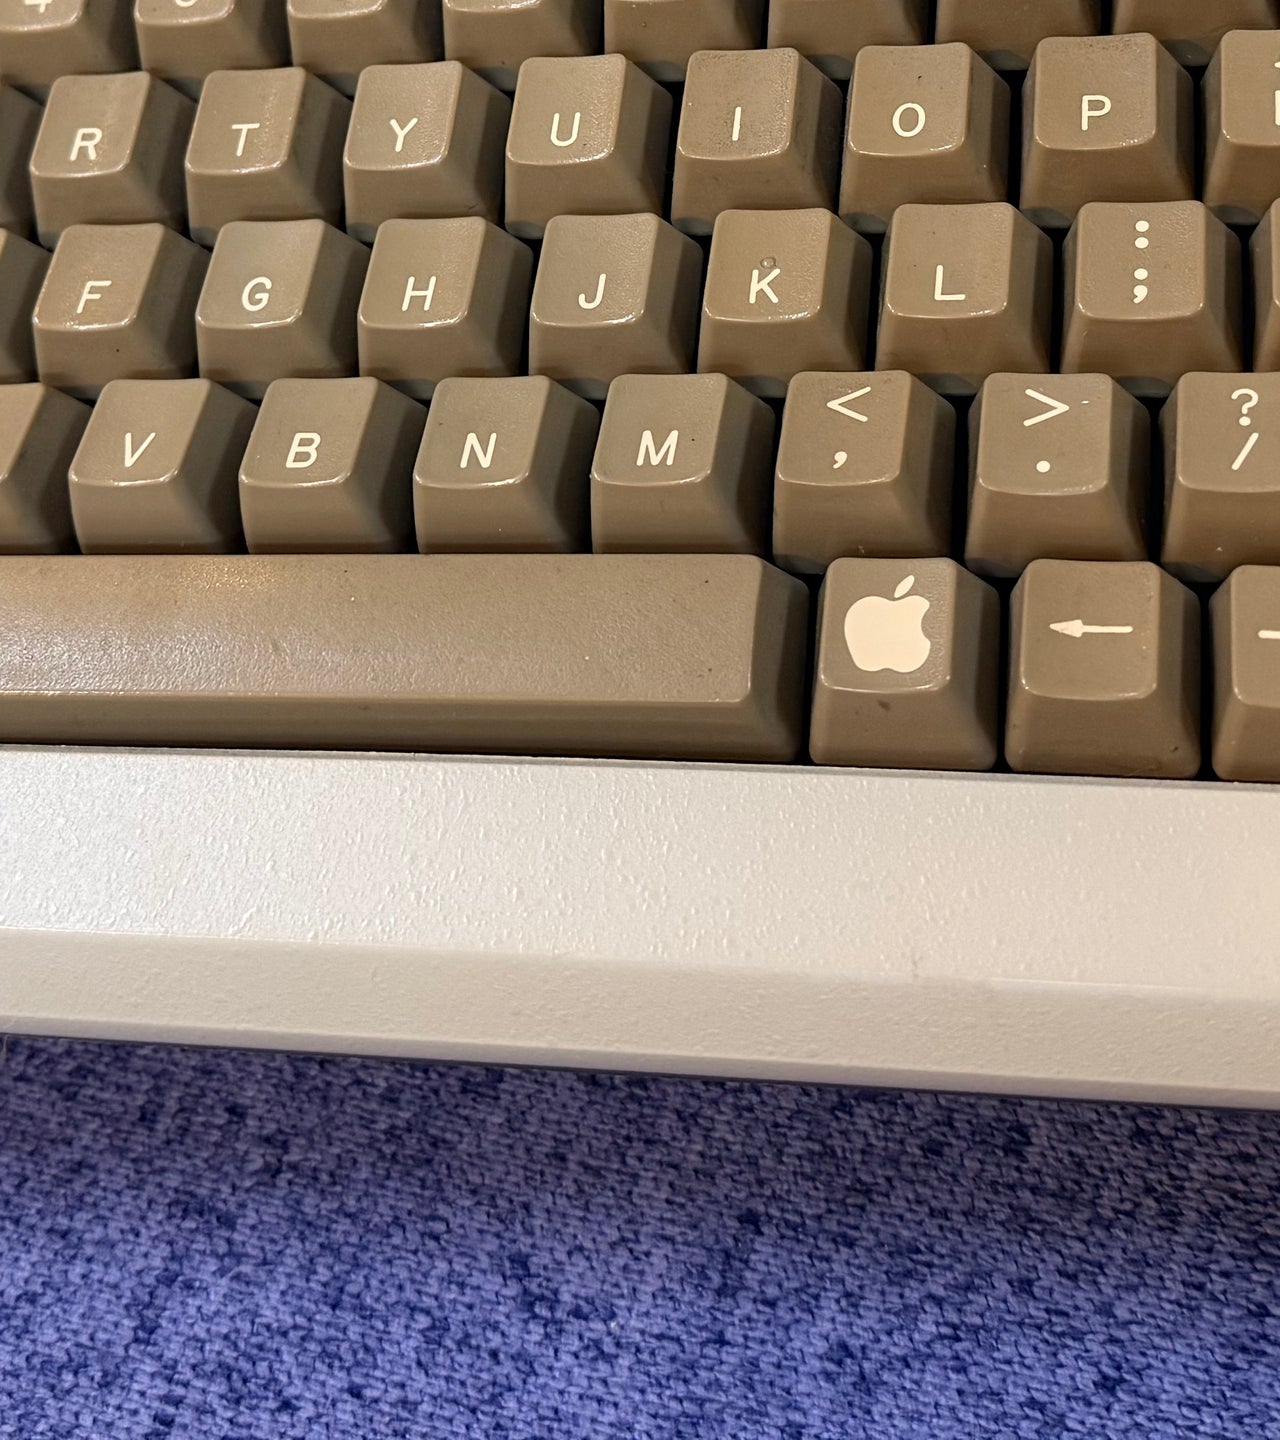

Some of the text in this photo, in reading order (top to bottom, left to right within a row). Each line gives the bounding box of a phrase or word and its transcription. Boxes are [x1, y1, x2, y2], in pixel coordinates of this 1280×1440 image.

[550, 111, 581, 148] U
[1081, 94, 1112, 132] P
[69, 127, 103, 161] R
[231, 123, 261, 157] T
[389, 117, 418, 153] Y
[76, 280, 113, 315] F
[241, 276, 273, 312] G
[401, 275, 437, 311] H
[577, 273, 607, 310] J
[747, 267, 781, 304] K
[933, 264, 966, 301] L
[1230, 387, 1259, 427] ?
[123, 432, 157, 468] V
[284, 432, 322, 469] B
[459, 432, 497, 469] N
[635, 429, 679, 467] M
